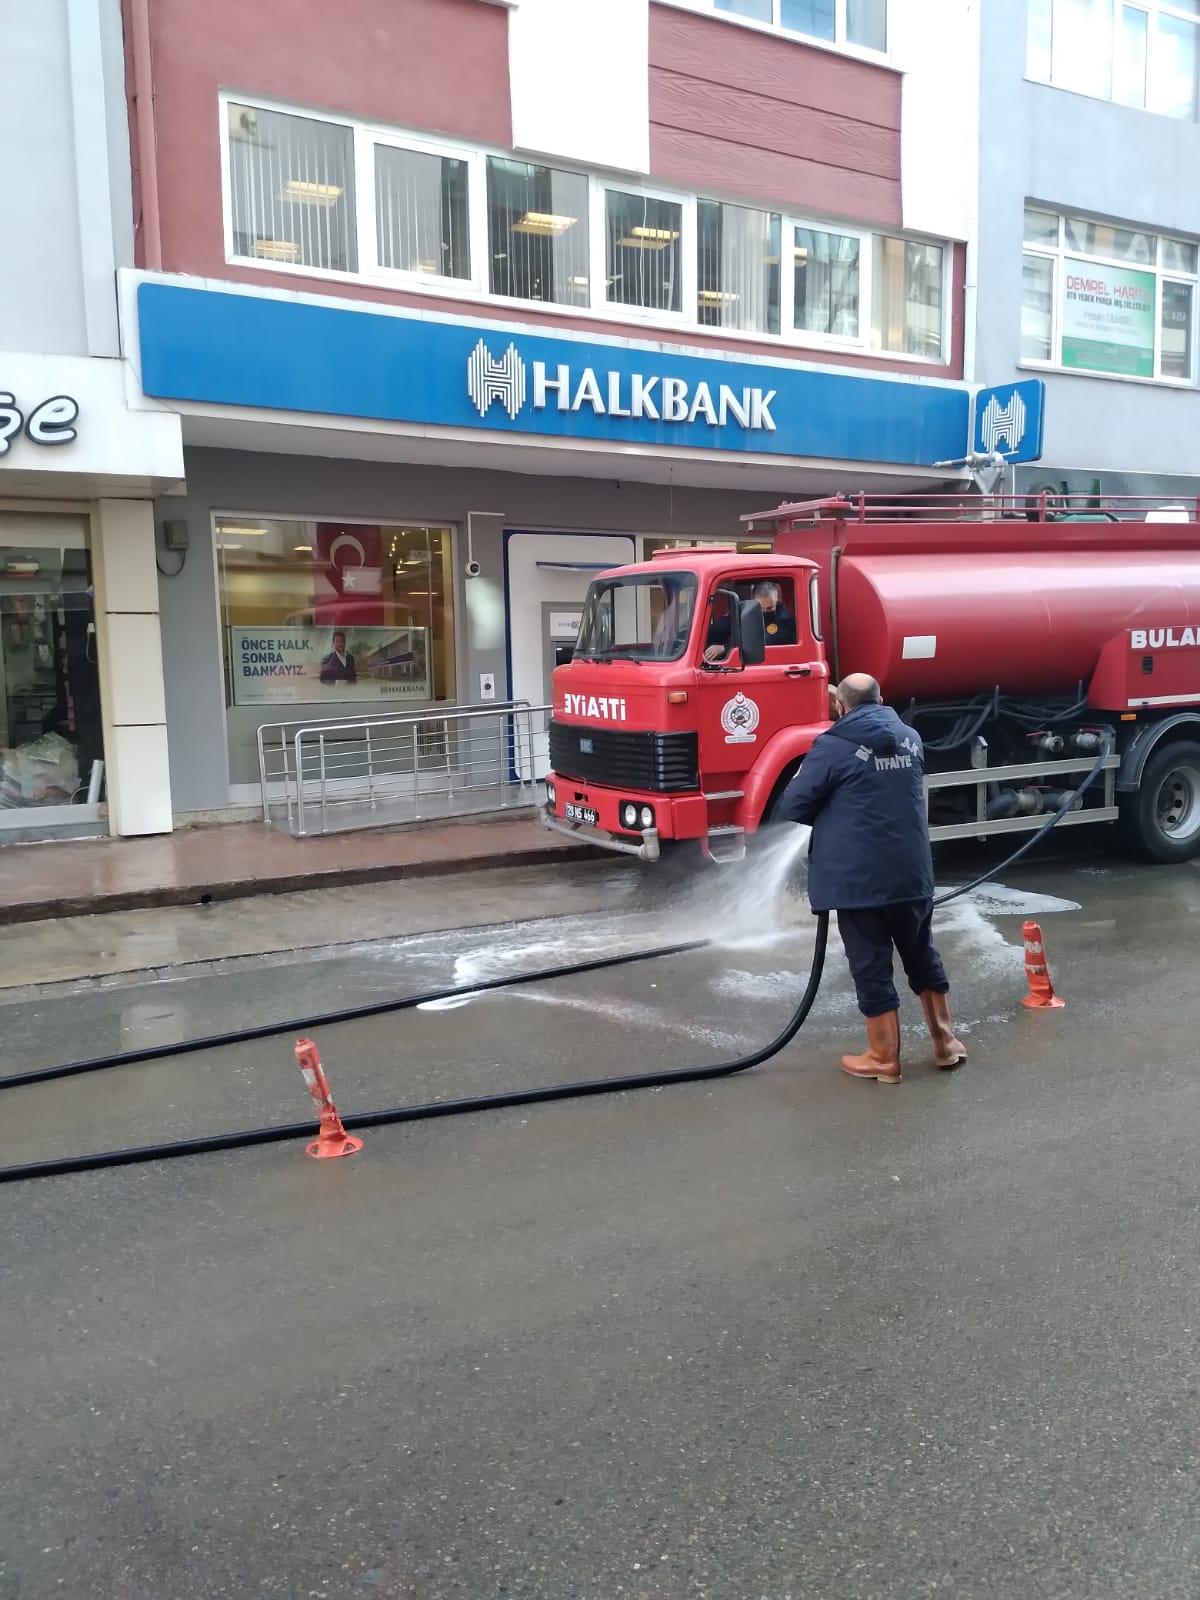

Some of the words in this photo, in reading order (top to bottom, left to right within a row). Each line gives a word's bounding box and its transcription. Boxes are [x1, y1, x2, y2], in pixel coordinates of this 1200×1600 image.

[532, 360, 777, 431] HALKBANK
[241, 637, 275, 651] ÖNCE
[277, 639, 314, 652] HALK,
[1131, 627, 1200, 649] BULA
[242, 652, 284, 664] SONRA
[243, 664, 307, 677] BANKAYIZ.
